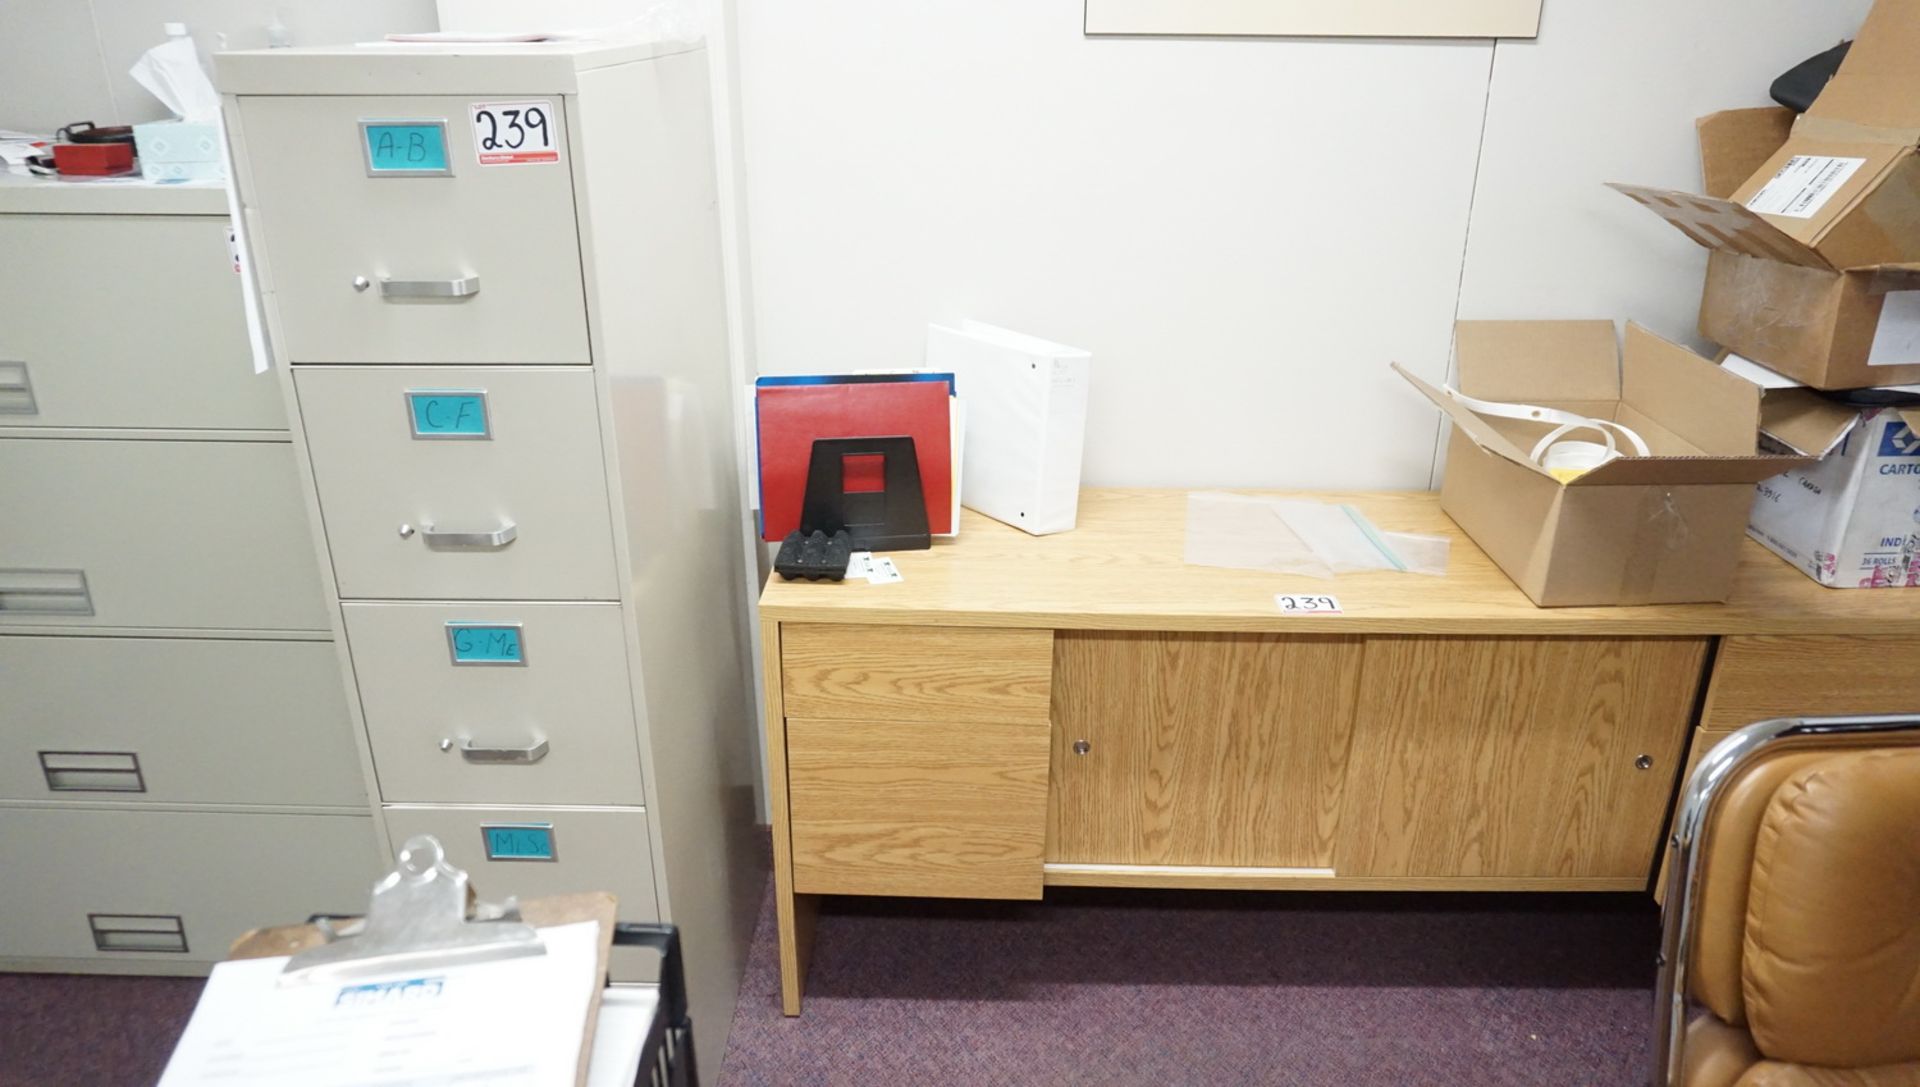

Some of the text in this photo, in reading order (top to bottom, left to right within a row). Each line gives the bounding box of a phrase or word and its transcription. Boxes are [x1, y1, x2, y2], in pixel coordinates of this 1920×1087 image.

[476, 107, 549, 150] 239
[376, 131, 426, 162] A-B
[1280, 596, 1336, 610] 239
